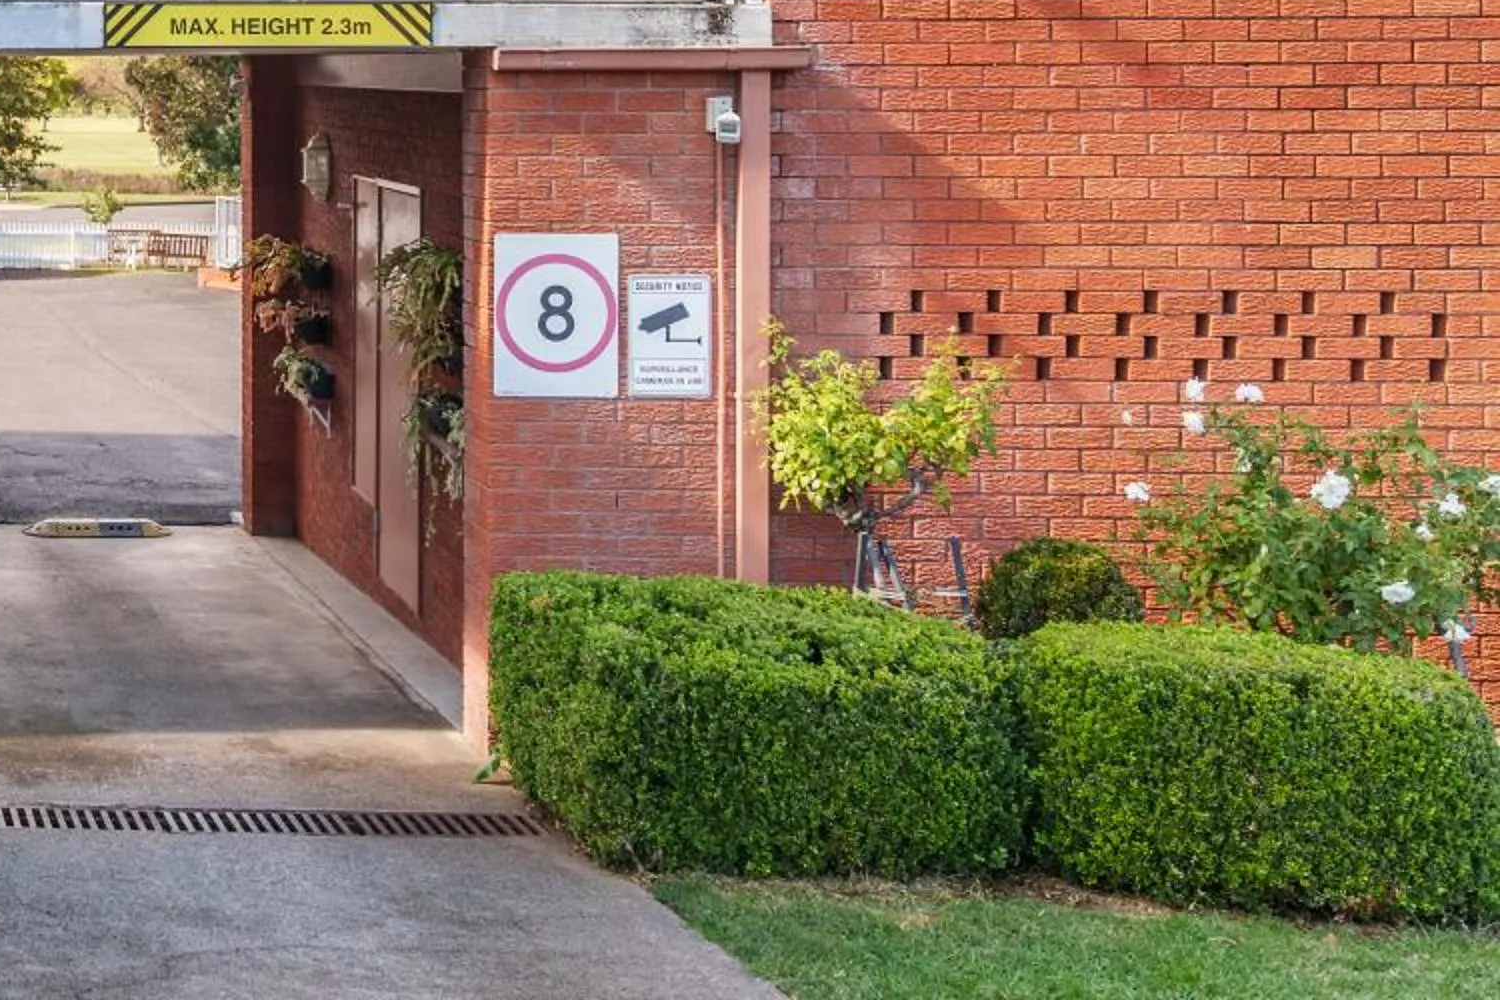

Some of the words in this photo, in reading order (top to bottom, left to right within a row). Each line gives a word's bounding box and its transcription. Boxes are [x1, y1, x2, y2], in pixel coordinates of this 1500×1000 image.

[169, 17, 225, 35] MAX.
[231, 17, 315, 35] HEIGHT
[320, 17, 372, 35] 2.3m
[537, 284, 575, 342] 8
